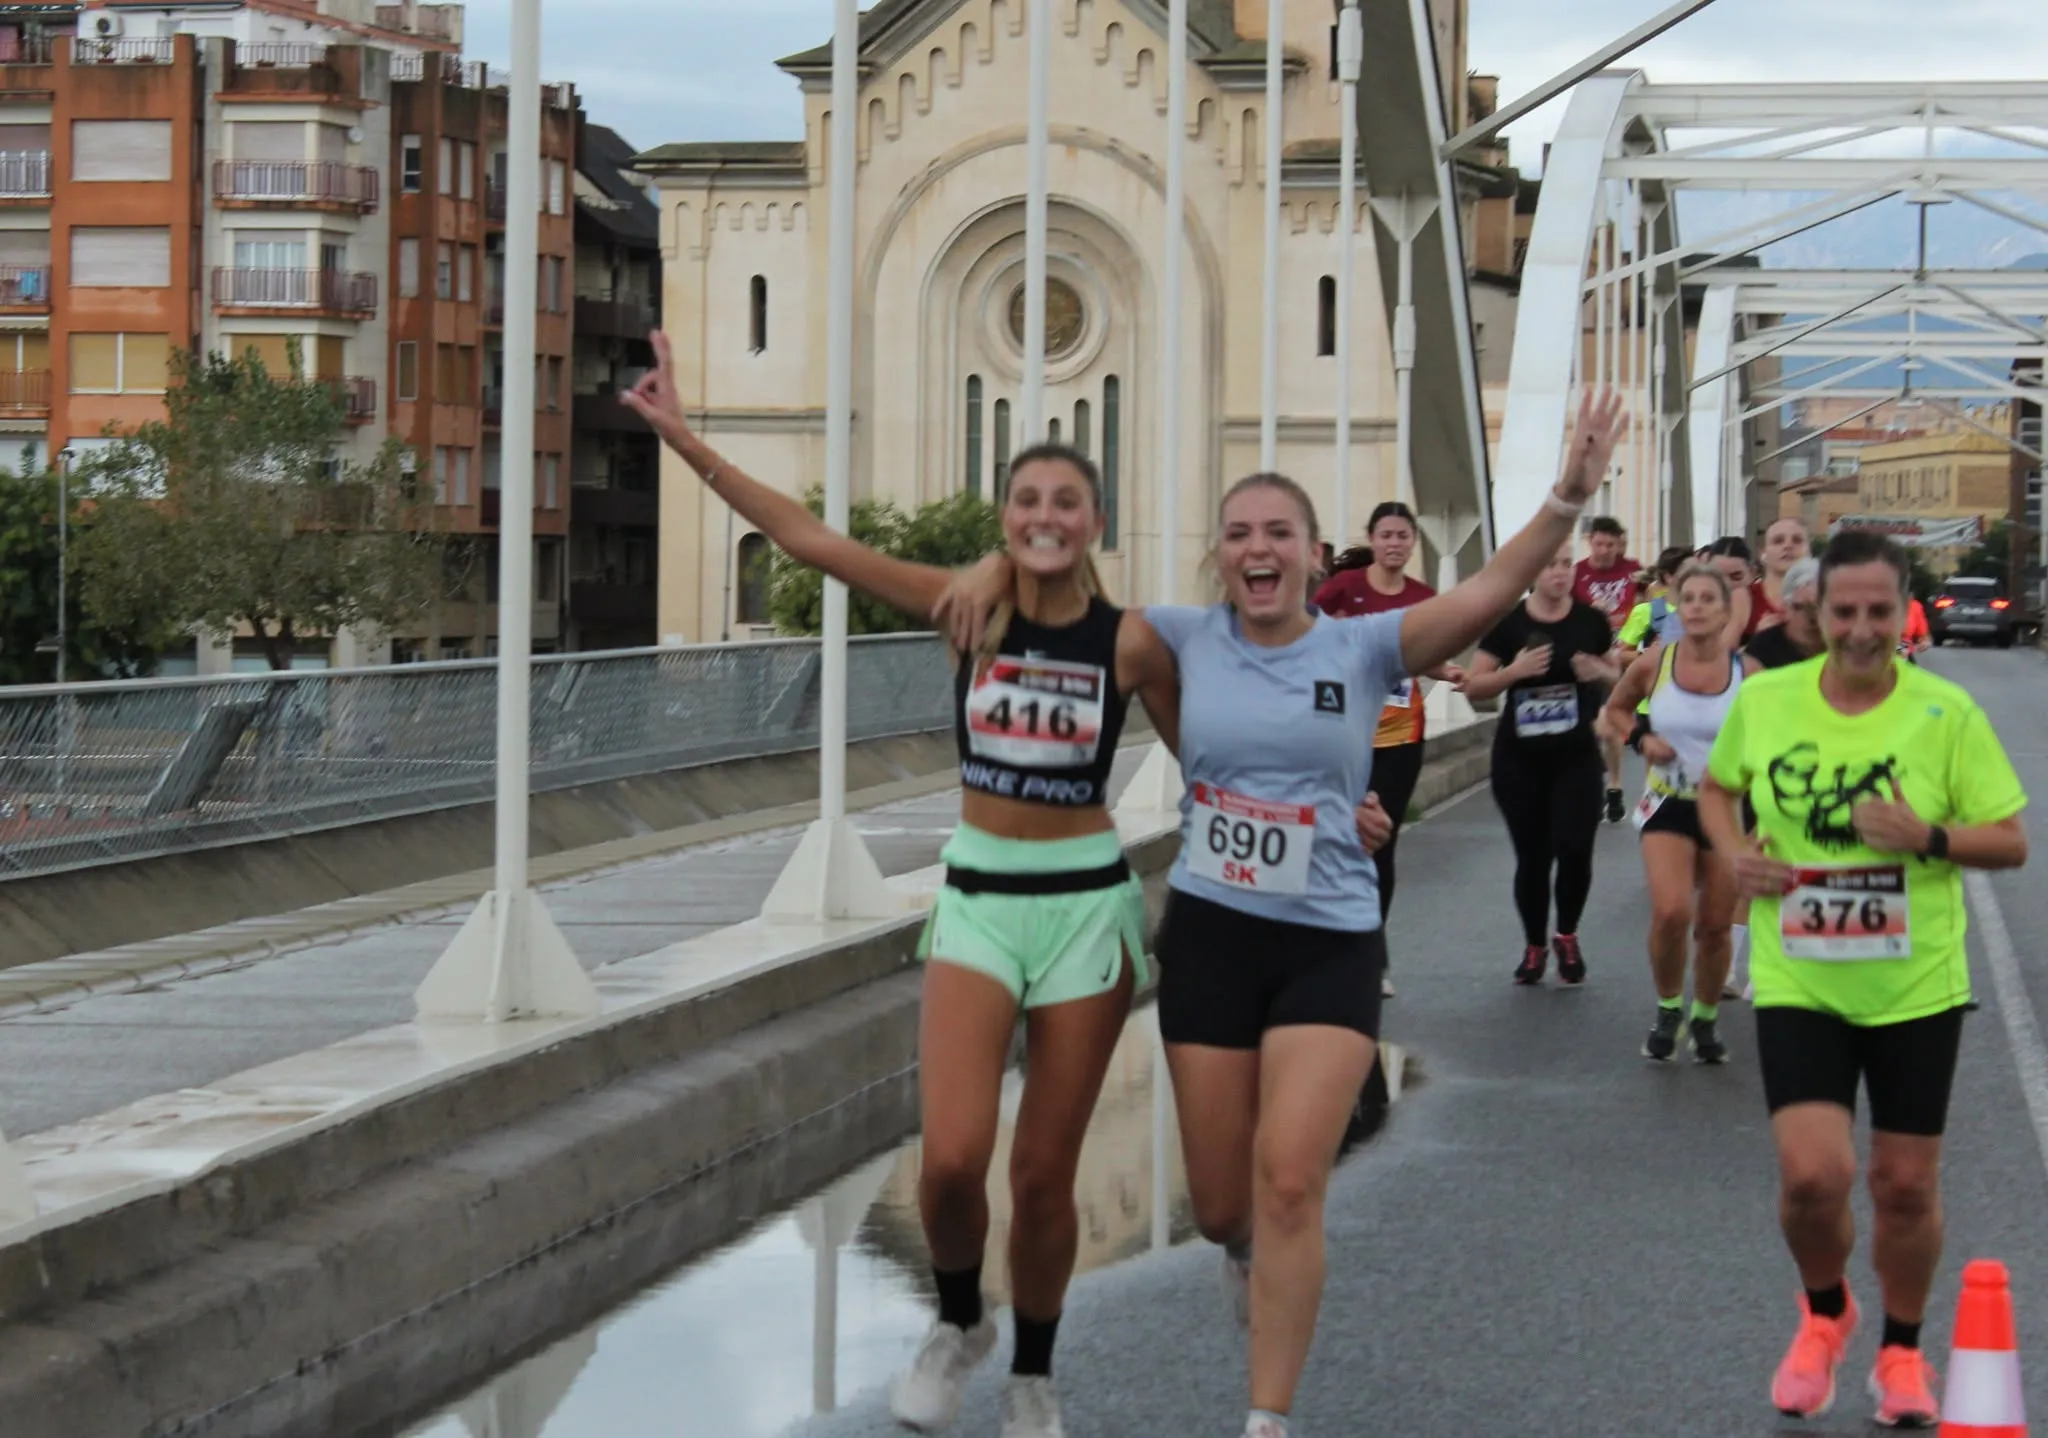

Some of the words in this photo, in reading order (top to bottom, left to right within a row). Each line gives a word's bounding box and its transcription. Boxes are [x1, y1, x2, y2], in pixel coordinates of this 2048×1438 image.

[985, 695, 1077, 739] 416
[961, 761, 1018, 794] NIKE
[1021, 775, 1093, 804] PRO
[1208, 813, 1287, 867] 690
[1222, 860, 1257, 886] 5K
[1801, 896, 1888, 934] 376
